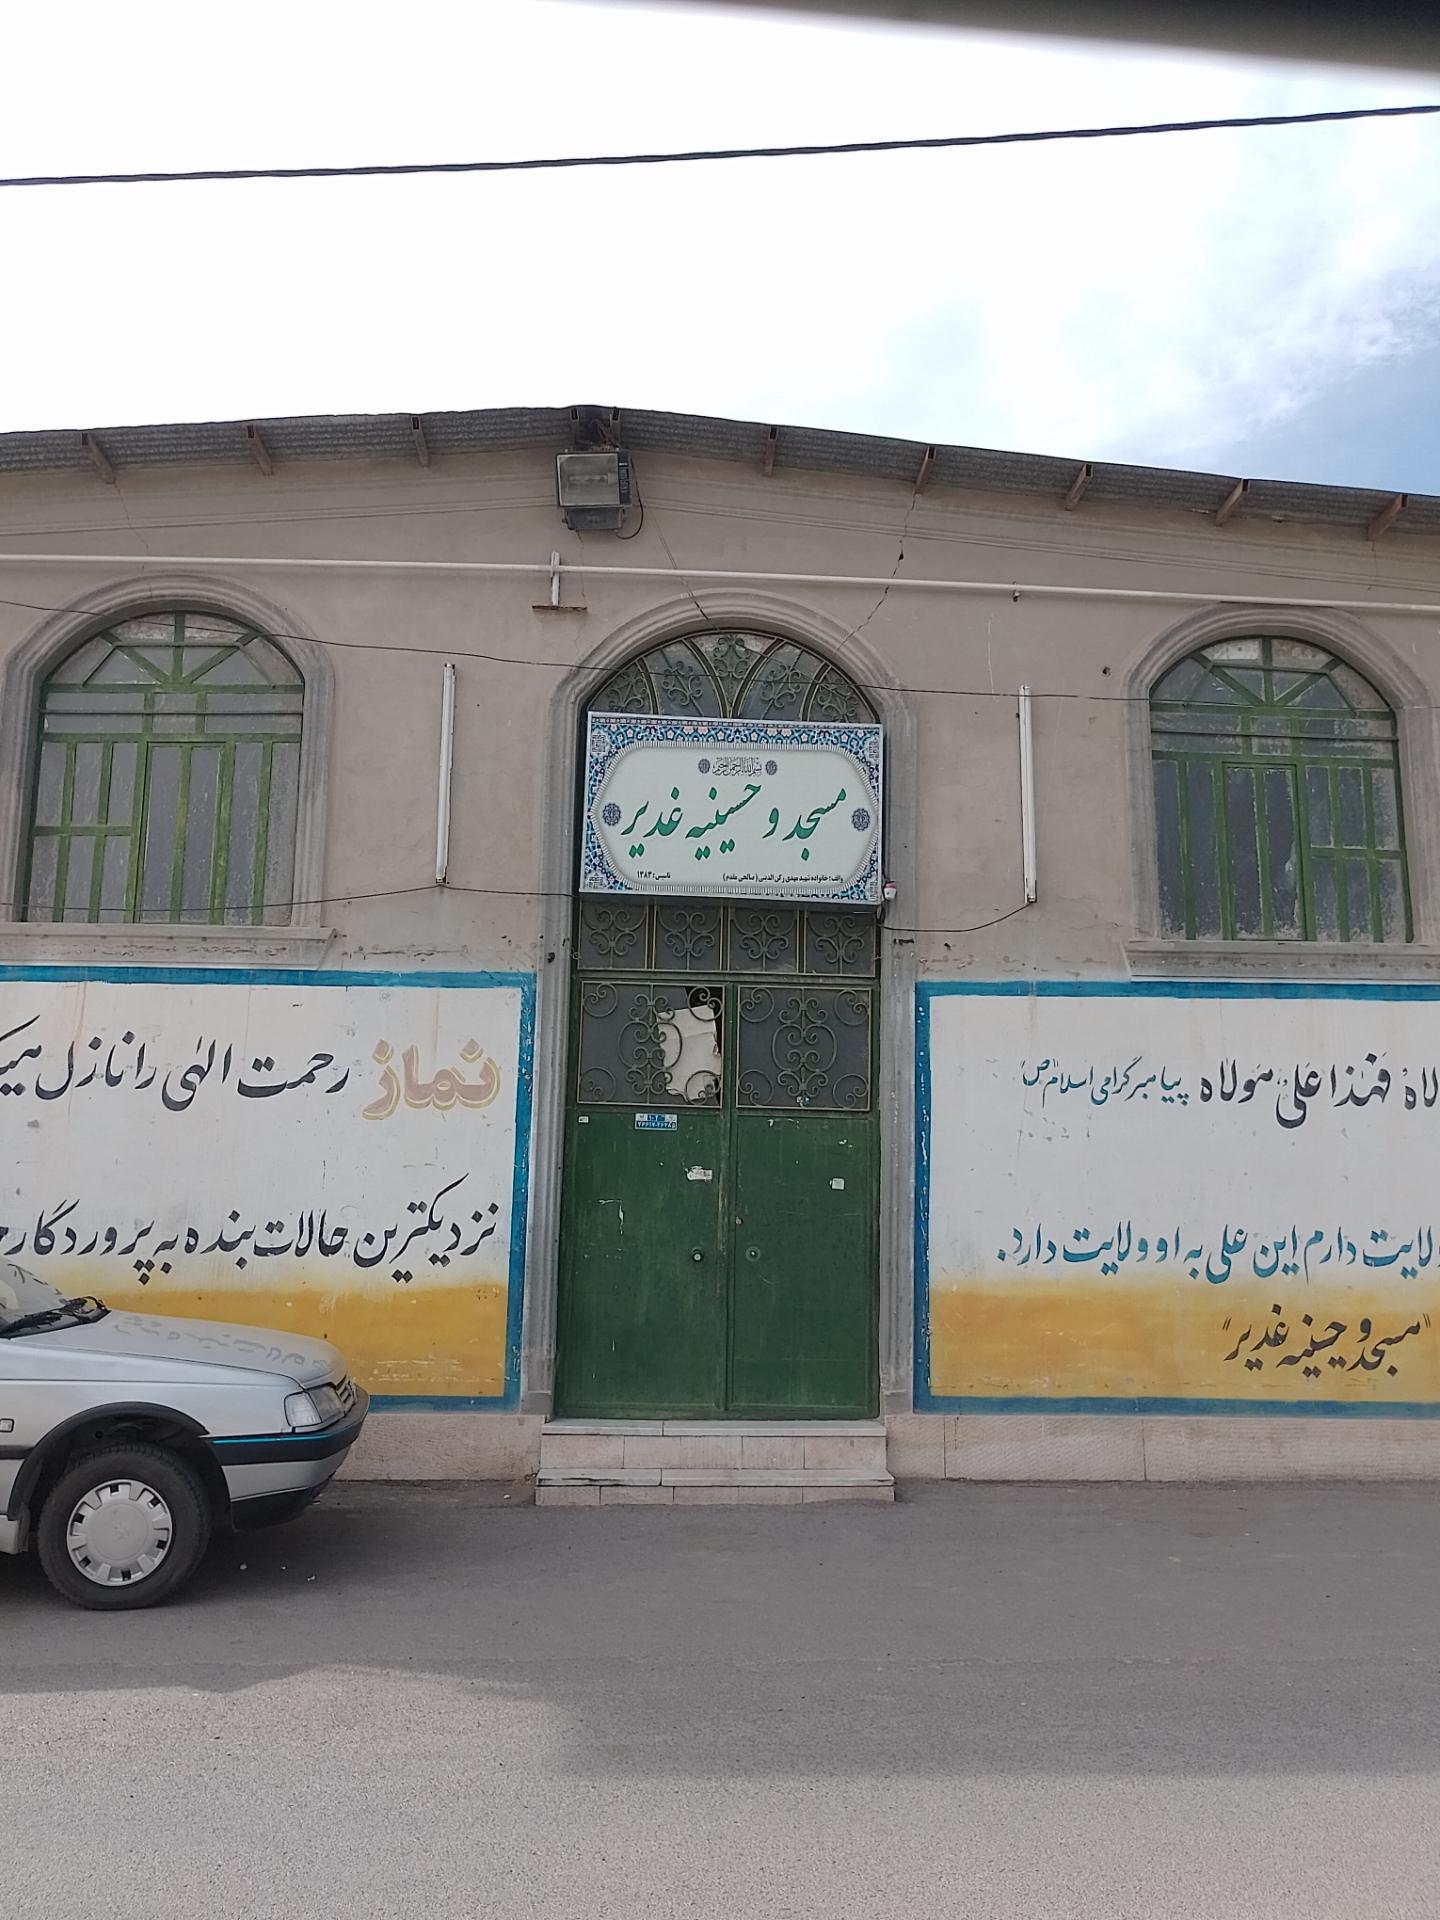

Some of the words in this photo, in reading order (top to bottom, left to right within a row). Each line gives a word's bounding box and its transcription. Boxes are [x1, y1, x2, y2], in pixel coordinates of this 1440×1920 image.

[620, 786, 684, 858] غدیر
[685, 783, 762, 861] حسینیه
[762, 806, 780, 839] و
[782, 787, 847, 861] مسجد
[35, 1030, 135, 1101] نازل
[135, 1040, 158, 1090] را
[237, 1047, 350, 1098] رحمت
[362, 1037, 501, 1120] نماز
[1042, 1066, 1094, 1109] اسلام
[1091, 1056, 1143, 1105] گرامی
[1124, 1065, 1190, 1107] پیامبر
[3, 1198, 157, 1286] پروردگار
[152, 1221, 184, 1275] به
[184, 1209, 256, 1271] بنده
[253, 1209, 349, 1258] حالات
[353, 1172, 500, 1285] نزدیکترین
[1062, 1220, 1148, 1277] ولایت
[1154, 1225, 1181, 1263] او
[1206, 1223, 1249, 1284] علی
[1252, 1224, 1299, 1279] این
[1304, 1225, 1357, 1286] دارم
[1361, 1225, 1440, 1281] لایت
[1184, 1243, 1204, 1281] به
[1276, 1312, 1348, 1380] حسینیه
[1356, 1317, 1372, 1343] و
